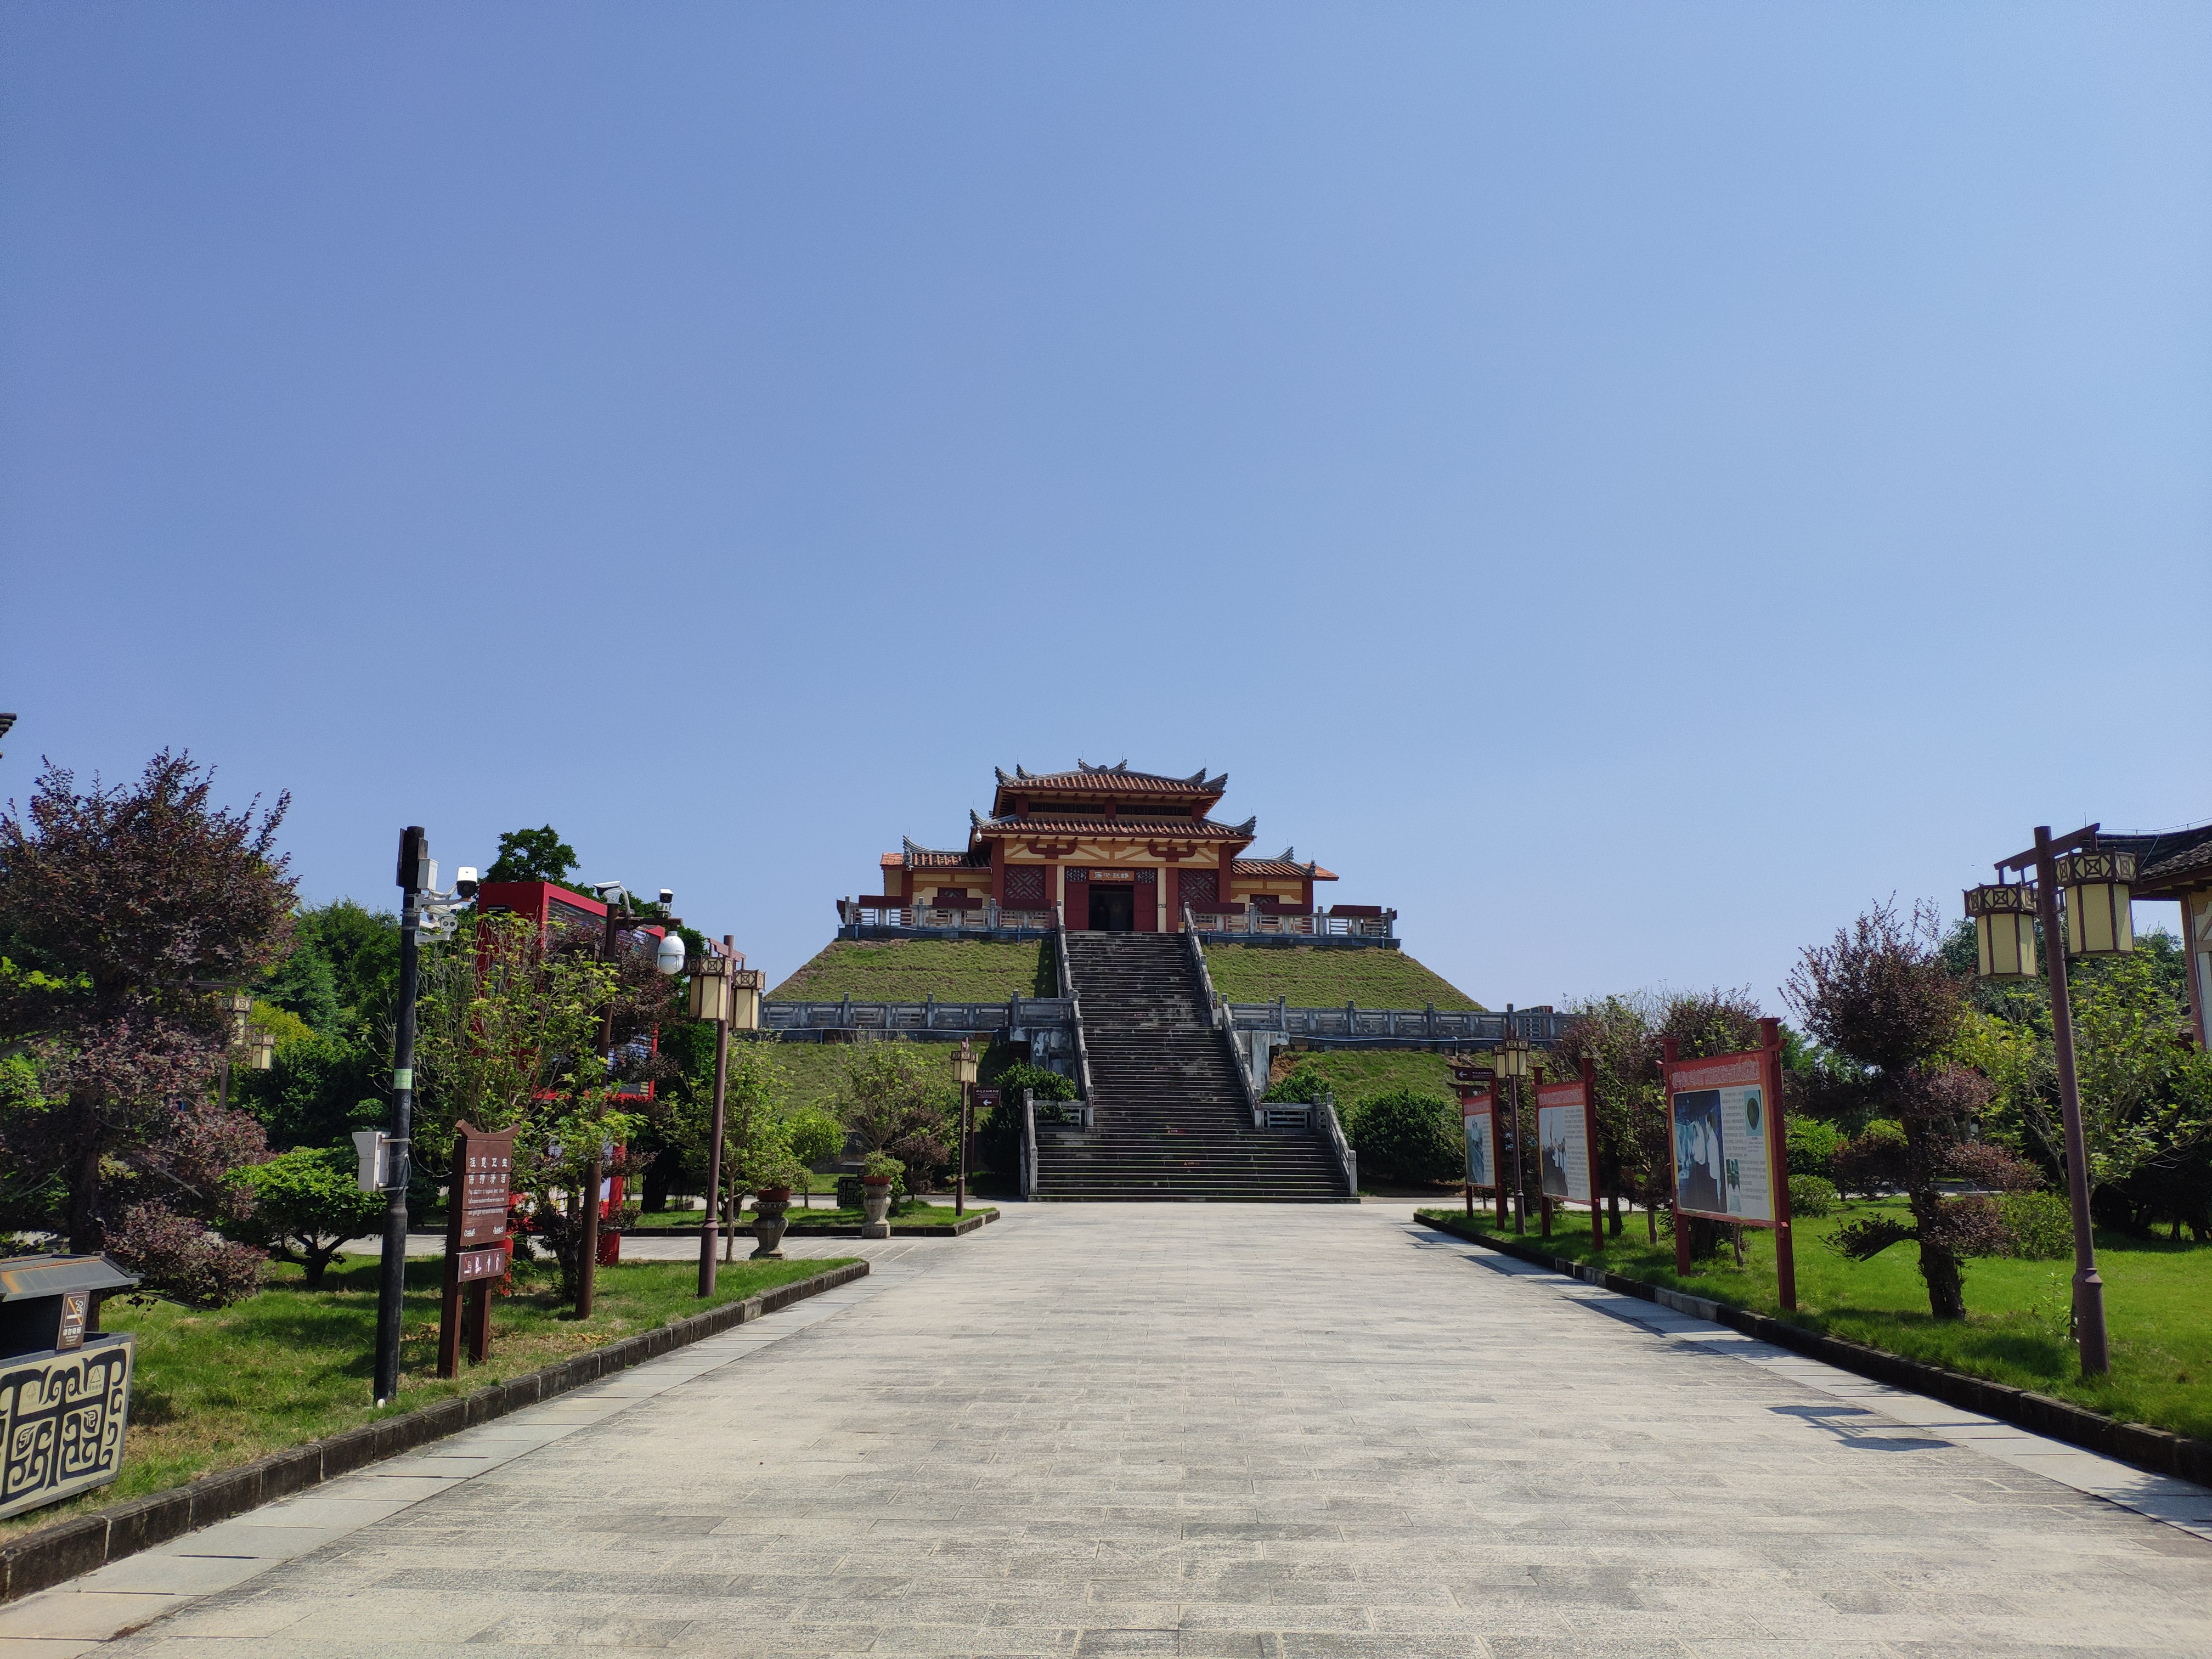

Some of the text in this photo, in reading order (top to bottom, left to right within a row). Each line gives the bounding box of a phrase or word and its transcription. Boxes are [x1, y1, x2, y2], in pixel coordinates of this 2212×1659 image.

[470, 1156, 507, 1169] 注意卫生
[469, 1171, 507, 1185] 保持清洁
